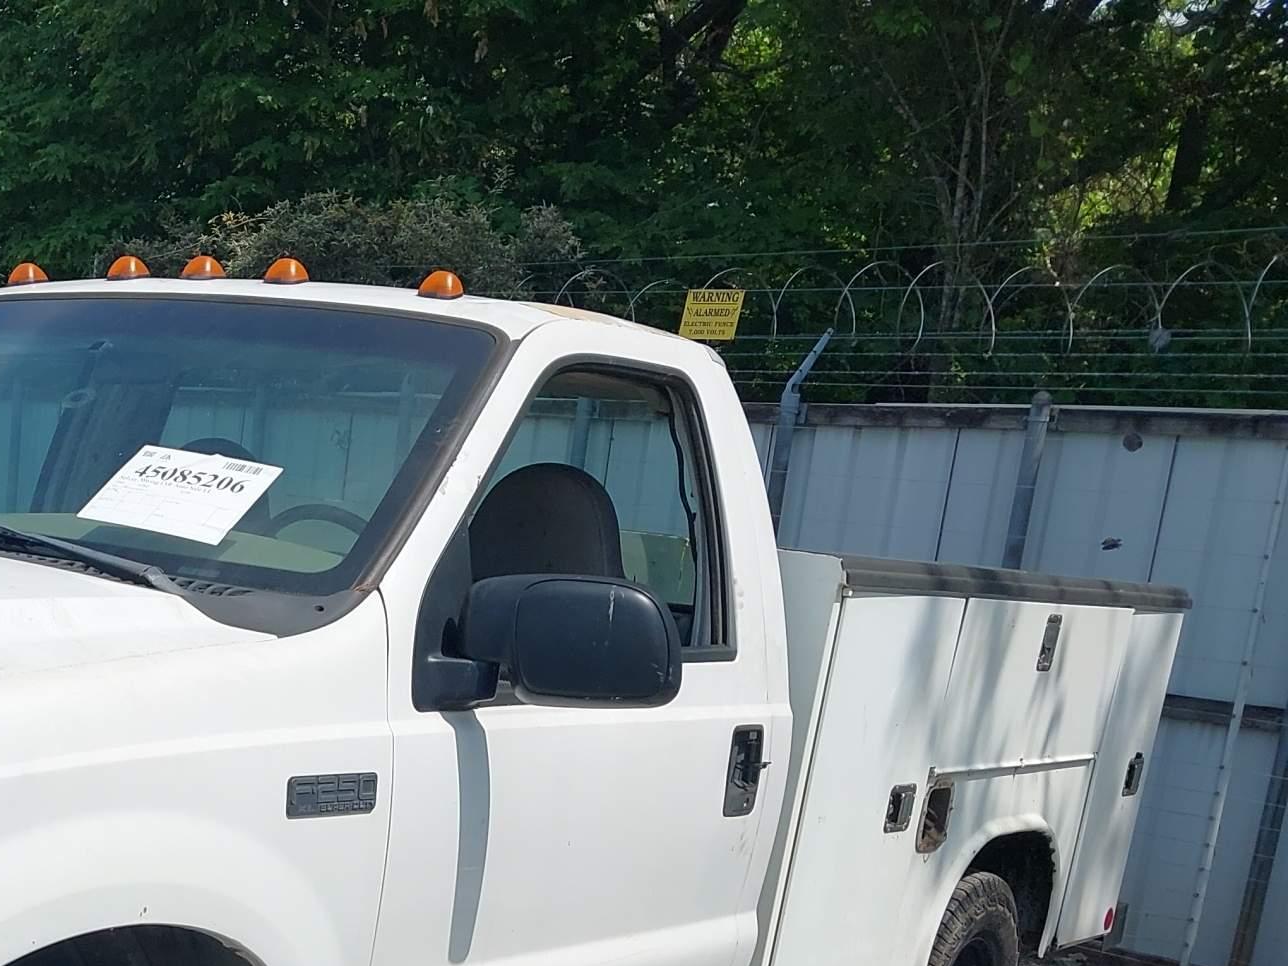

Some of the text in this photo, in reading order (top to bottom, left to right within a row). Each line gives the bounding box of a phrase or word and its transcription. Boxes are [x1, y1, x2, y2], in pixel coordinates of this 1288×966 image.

[692, 292, 739, 303] WARNING
[693, 308, 730, 317] ALARMED
[134, 464, 250, 494] 45085206
